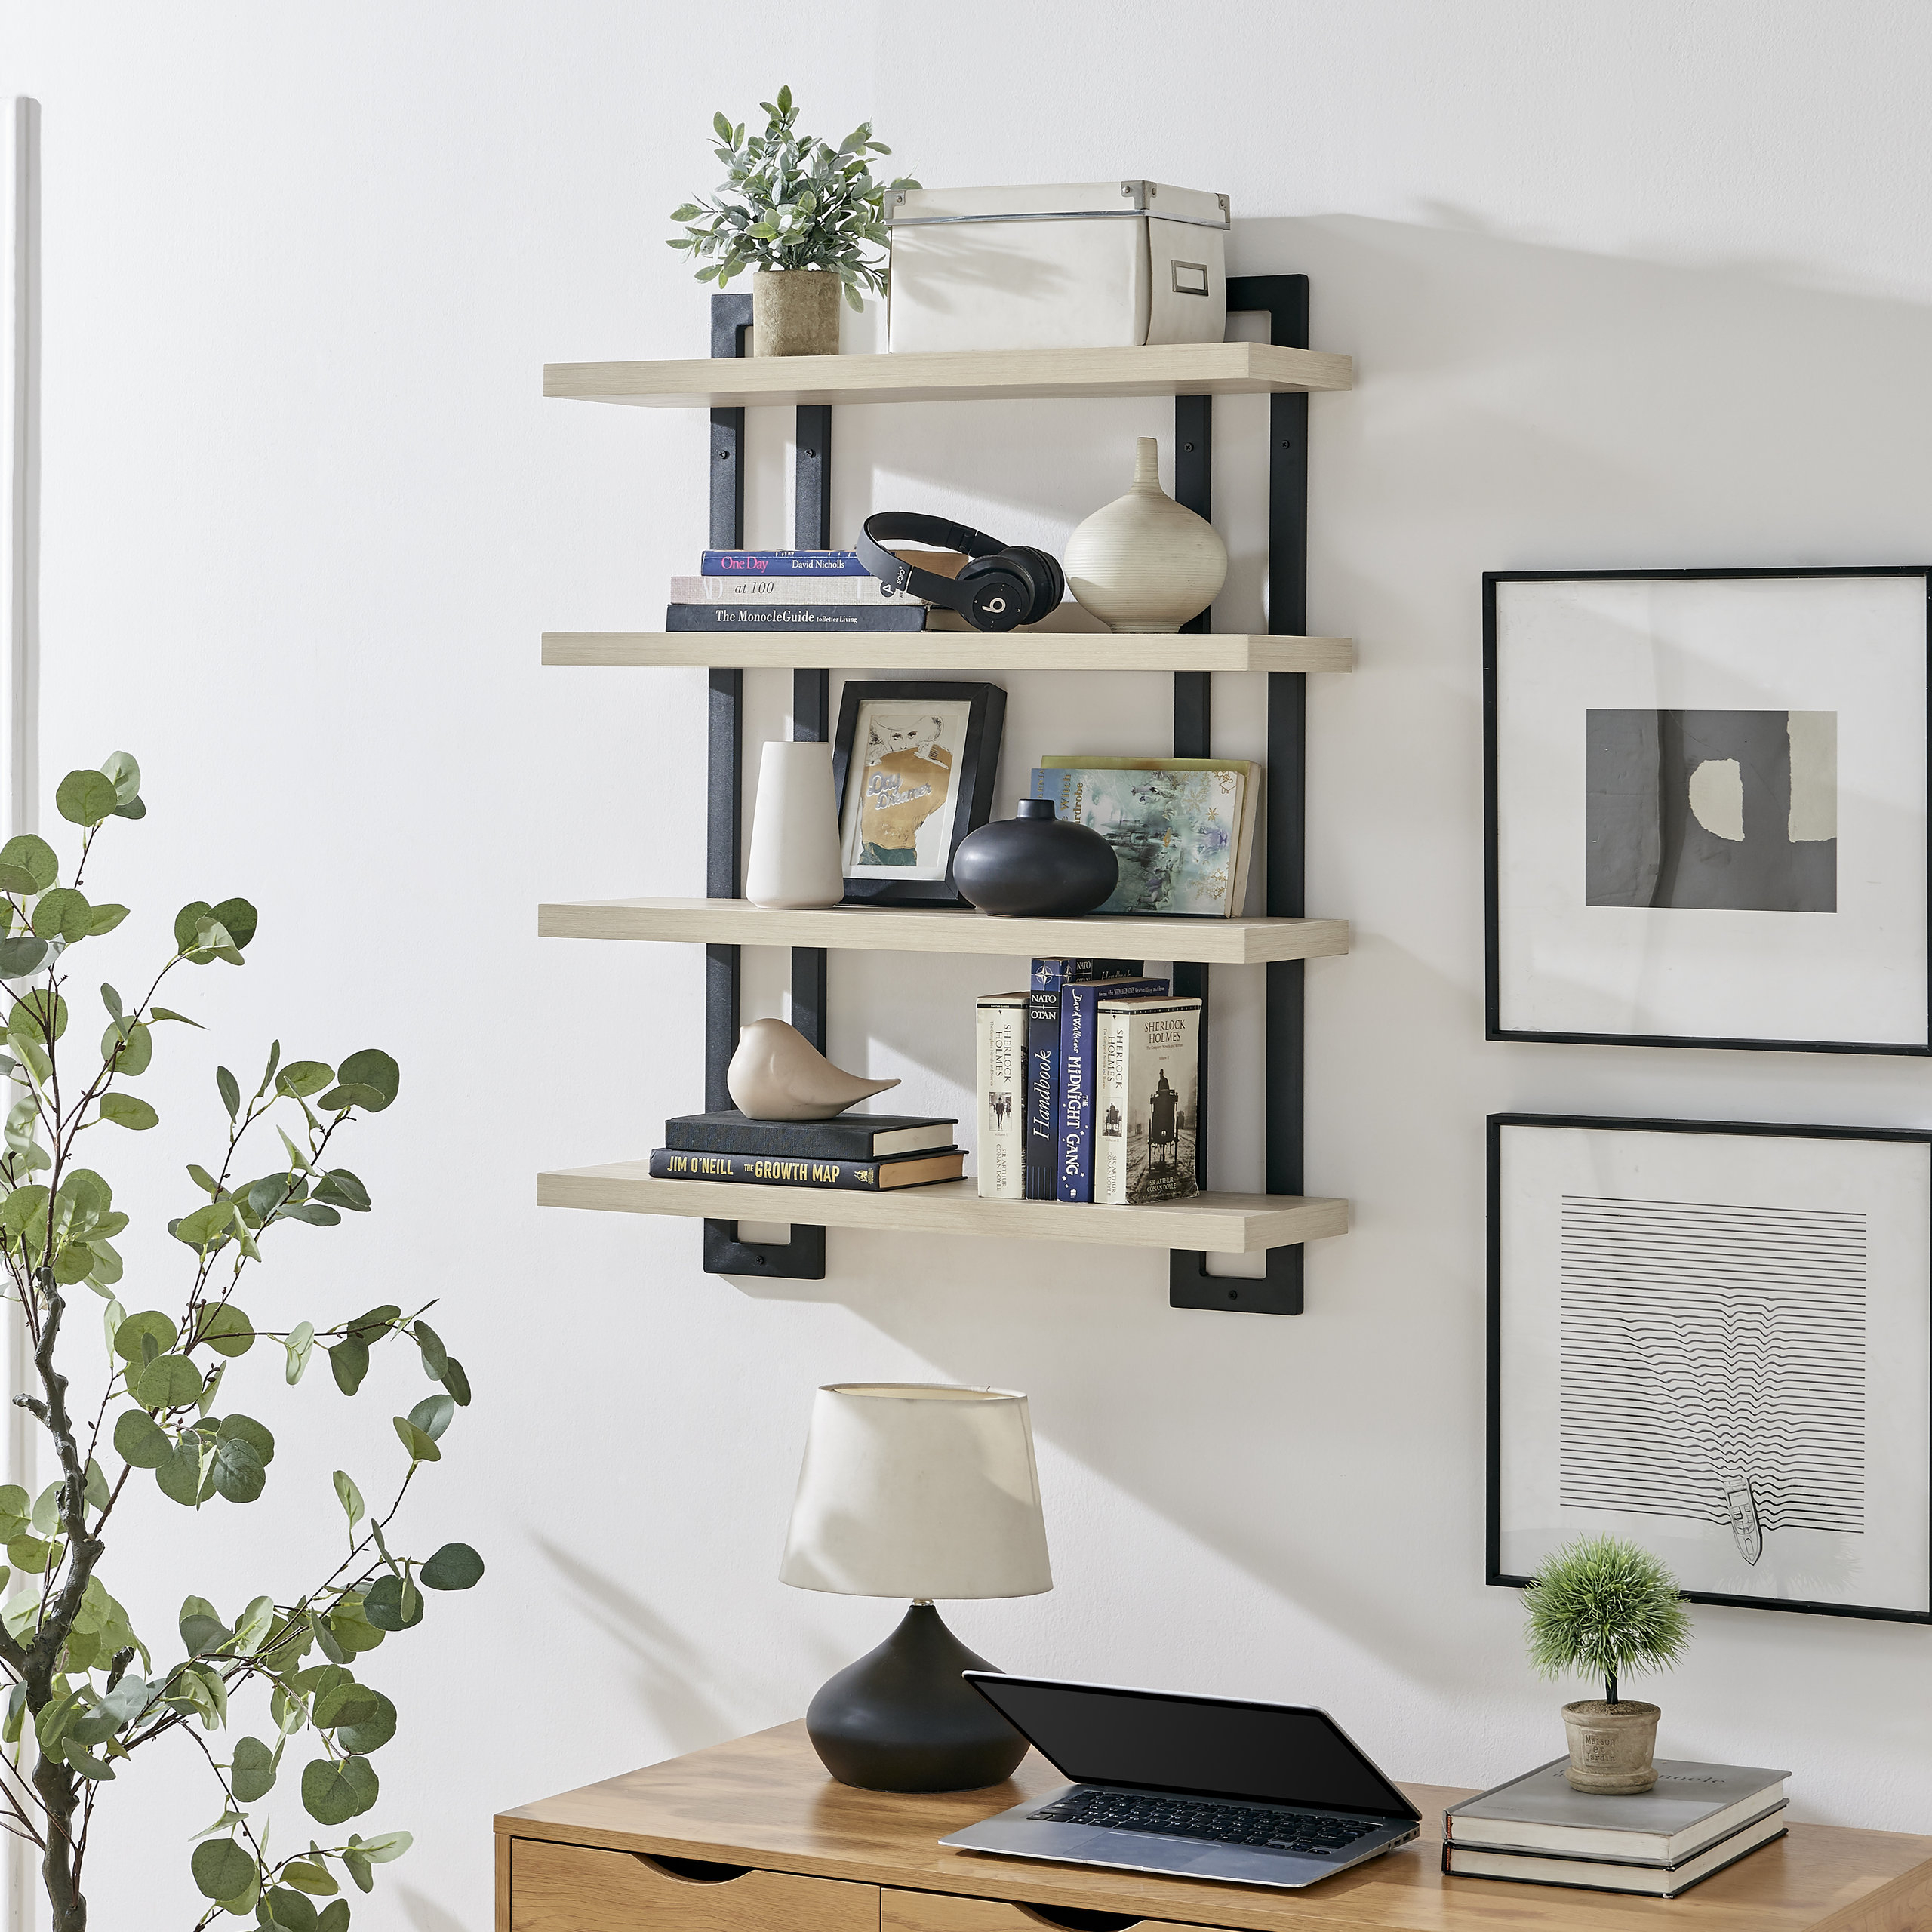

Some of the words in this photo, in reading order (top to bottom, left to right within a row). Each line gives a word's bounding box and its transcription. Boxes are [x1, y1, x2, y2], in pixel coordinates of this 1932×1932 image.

[721, 556, 745, 569] One
[746, 556, 769, 573] Day
[792, 559, 814, 569] David
[815, 559, 845, 569] Nicholls
[735, 583, 747, 594] at
[752, 581, 774, 594] 100
[715, 610, 736, 622] The
[839, 615, 858, 624] Living
[866, 771, 903, 798] Day
[1037, 768, 1045, 799] ARNIA
[1060, 774, 1072, 811] Witch
[875, 783, 932, 810] Dreamer
[1076, 961, 1091, 971] NATO
[1031, 994, 1057, 1004] NATO
[1072, 989, 1083, 1017] David
[1031, 1011, 1057, 1020] OTAN
[1144, 1019, 1186, 1032] SHERLOCK
[1072, 1017, 1081, 1054] Walliams
[1149, 1032, 1181, 1044] HOLMES
[995, 1031, 1004, 1077] HOLMES
[1004, 1024, 1012, 1084] SHERLOCK
[1107, 1036, 1115, 1082] HOLMES
[1115, 1029, 1124, 1089] SHERLOCK
[1033, 1049, 1051, 1141] Handbook
[1065, 1133, 1081, 1177] GANG
[667, 1155, 687, 1172] JIM
[691, 1157, 734, 1176] O'NEILL
[743, 1163, 754, 1172] THE
[755, 1160, 808, 1181] GROWTH
[812, 1164, 841, 1183] MAP
[1147, 1184, 1163, 1192] CONAN
[1157, 1177, 1174, 1185] ARTHUR
[1586, 1735, 1615, 1746] Maison
[1586, 1752, 1616, 1761] Jardin
[1658, 1774, 1727, 1783] nocle
